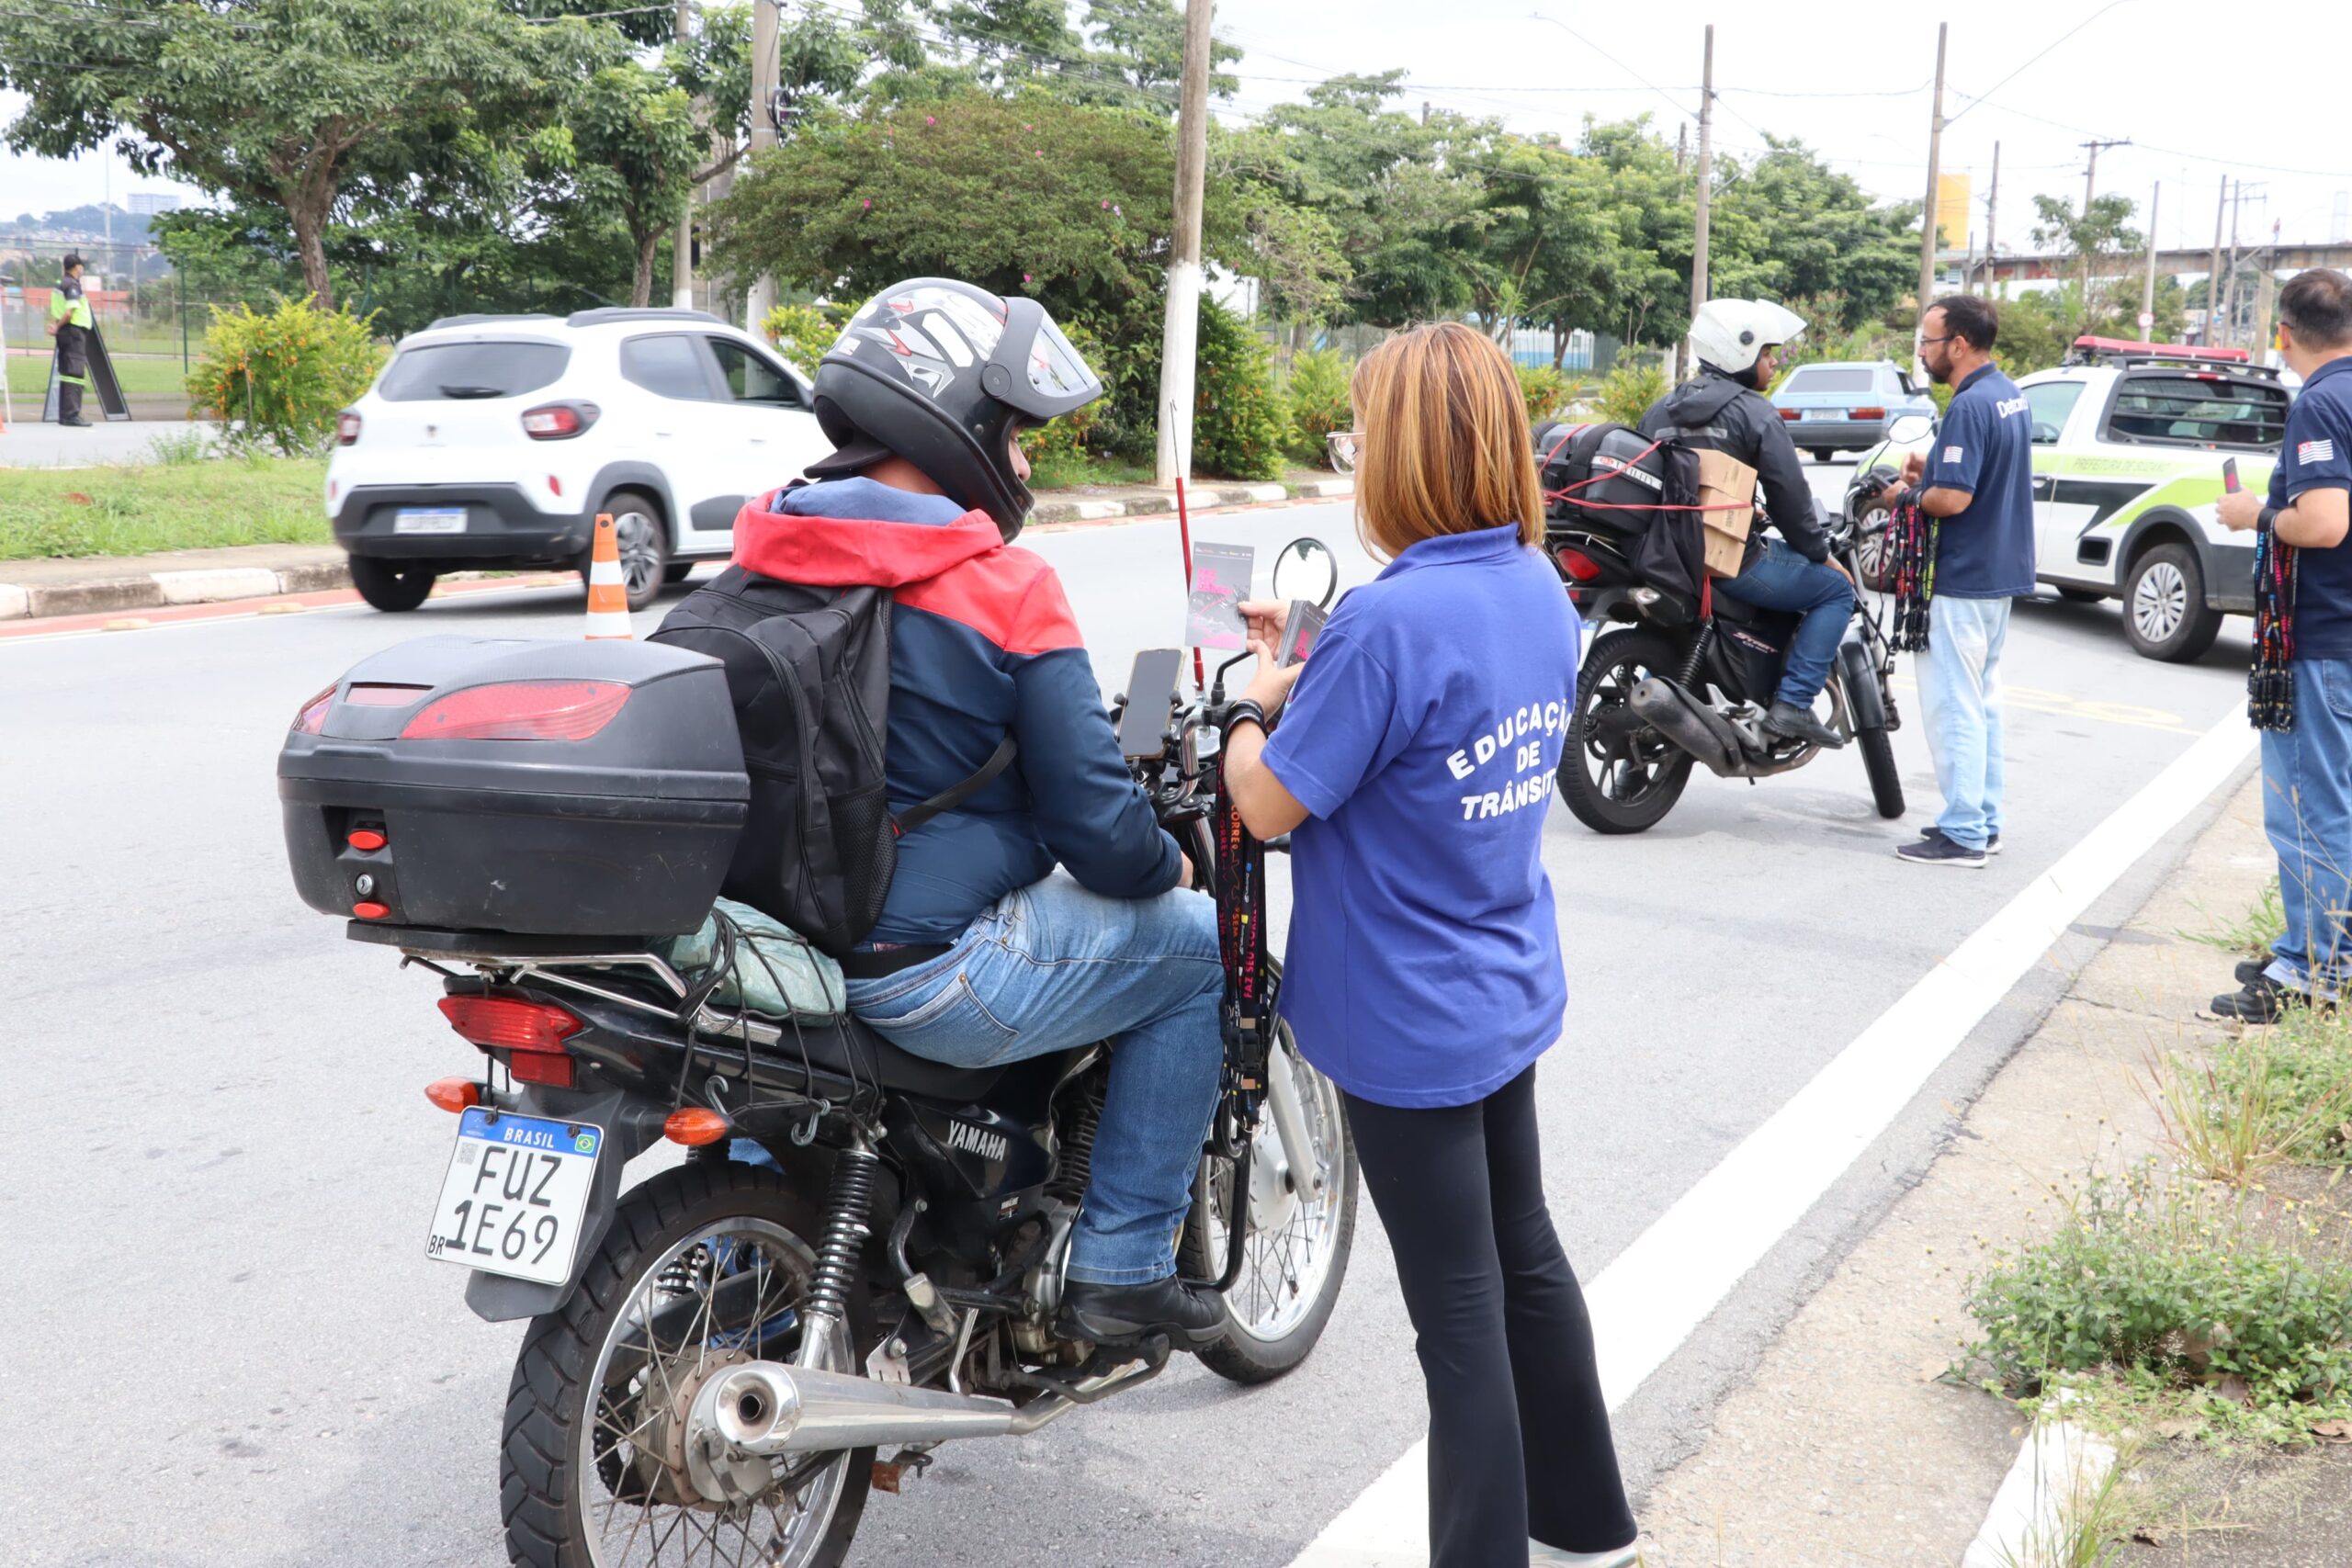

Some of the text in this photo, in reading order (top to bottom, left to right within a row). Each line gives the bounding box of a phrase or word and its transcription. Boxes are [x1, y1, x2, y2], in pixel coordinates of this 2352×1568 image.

[1517, 740, 1541, 773] DE
[1244, 952, 1255, 974] SEU
[1243, 976, 1253, 998] FAZ
[503, 1127, 555, 1148] BRASIL
[948, 1120, 1007, 1161] YAMAHA
[473, 1145, 562, 1208] FUZ
[427, 1235, 446, 1256] BR
[445, 1200, 559, 1265] 1E69
